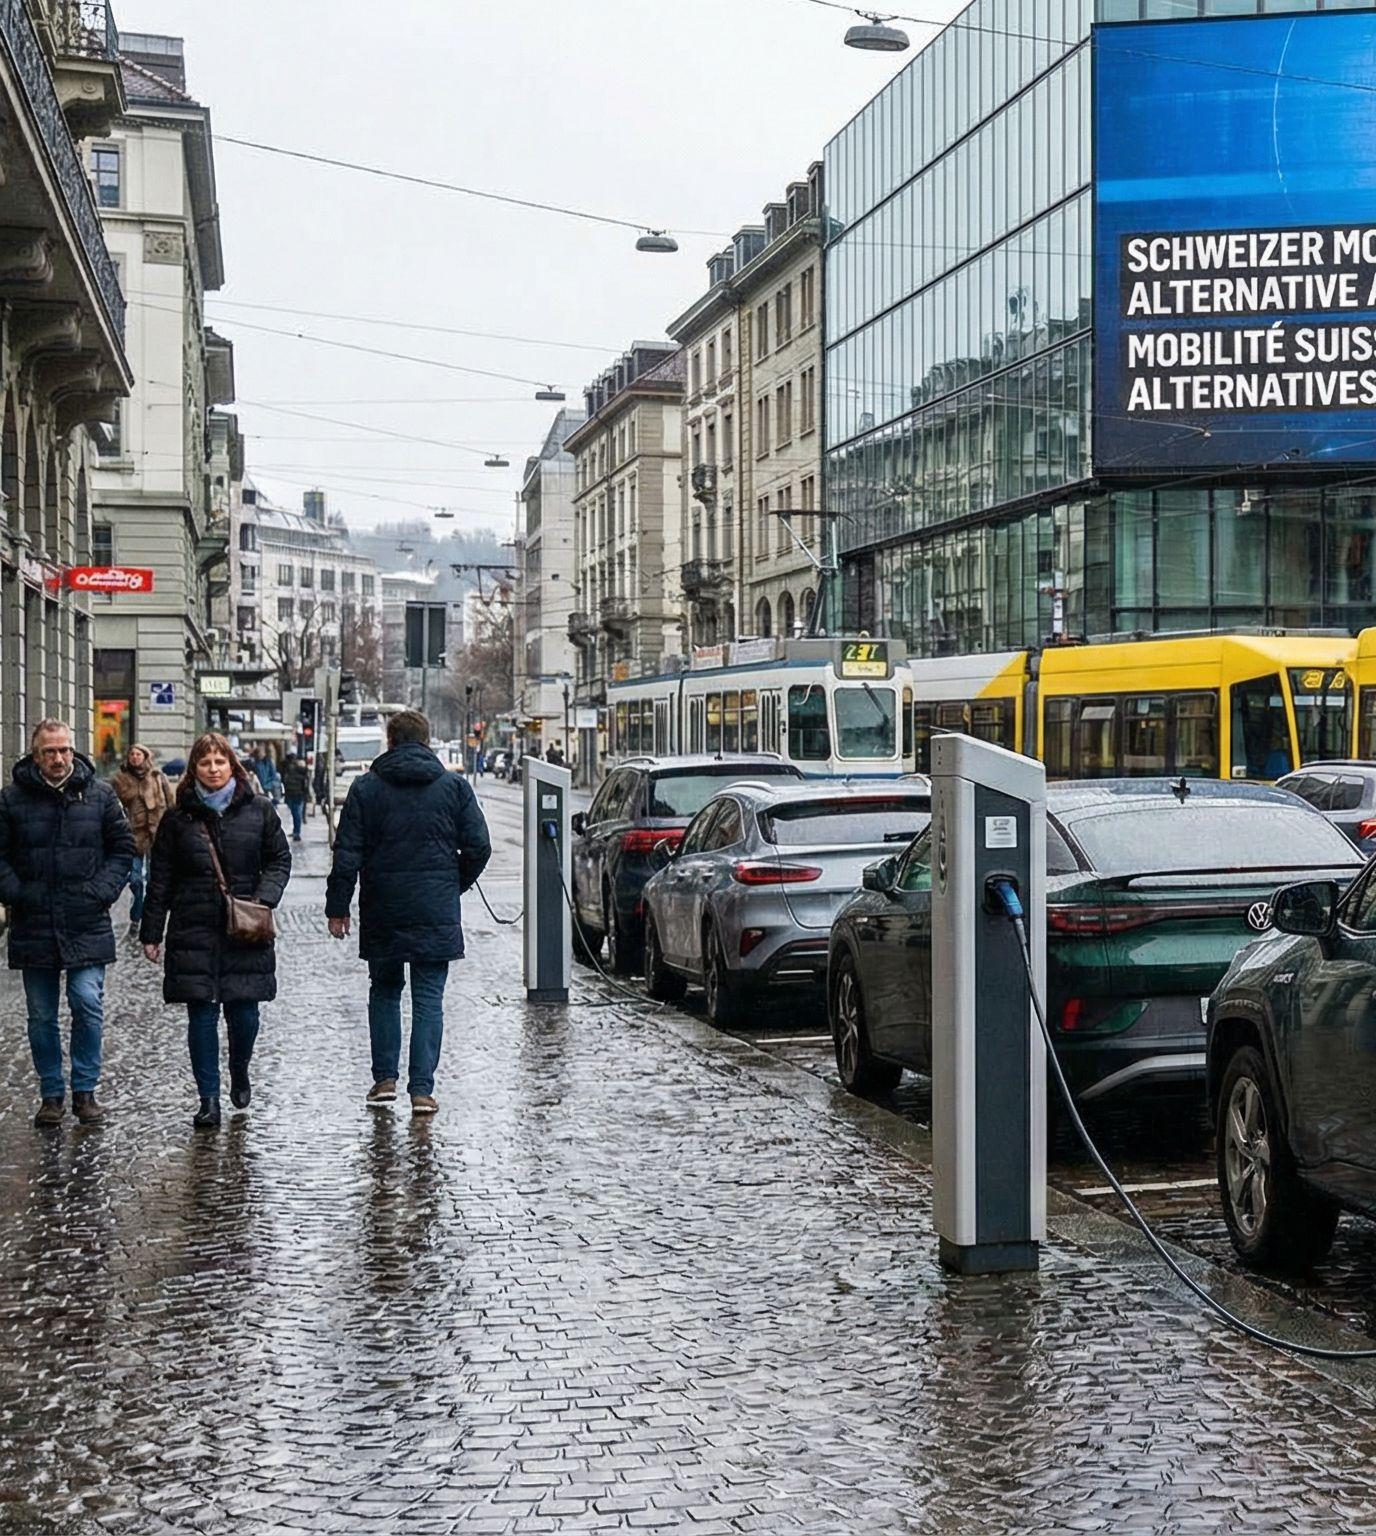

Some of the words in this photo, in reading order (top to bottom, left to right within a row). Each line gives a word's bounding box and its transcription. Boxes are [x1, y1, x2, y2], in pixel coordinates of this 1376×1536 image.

[1127, 231, 1324, 273] SCHWEIZER
[1126, 273, 1359, 316] ALTERNATIVE
[1128, 320, 1285, 368] MOBILITÉ
